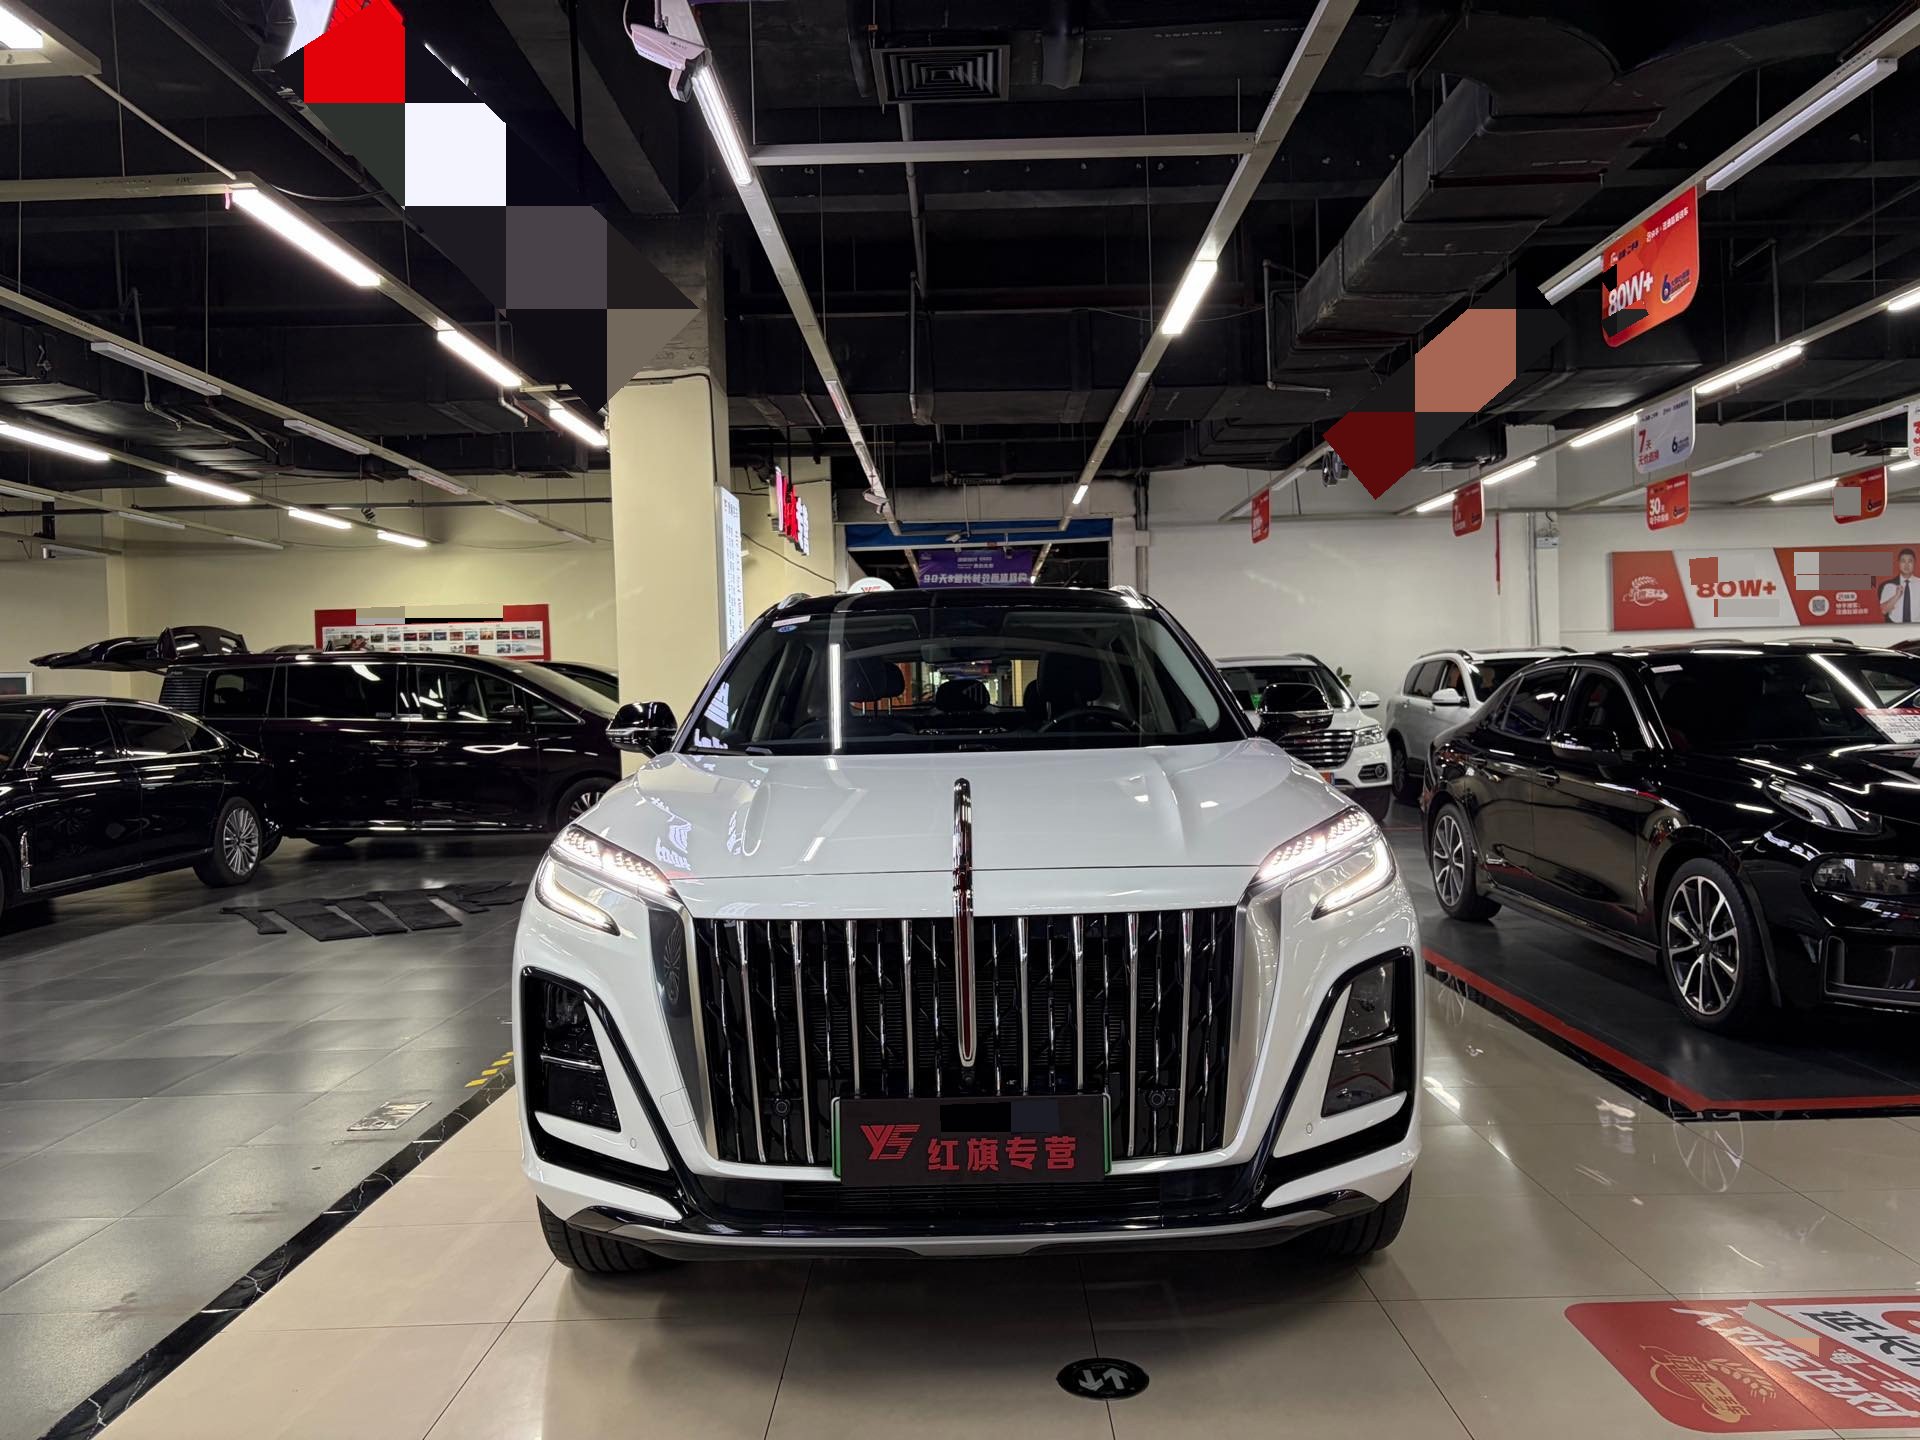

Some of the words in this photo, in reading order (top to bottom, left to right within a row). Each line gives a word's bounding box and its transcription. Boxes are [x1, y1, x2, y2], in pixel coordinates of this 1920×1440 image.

[1608, 270, 1654, 316] 80W+
[1696, 579, 1776, 598] 80W+
[927, 1136, 1078, 1171] 红旗专营
[1800, 1310, 1920, 1367] 延长
[1670, 1308, 1920, 1418] 人对车也对
